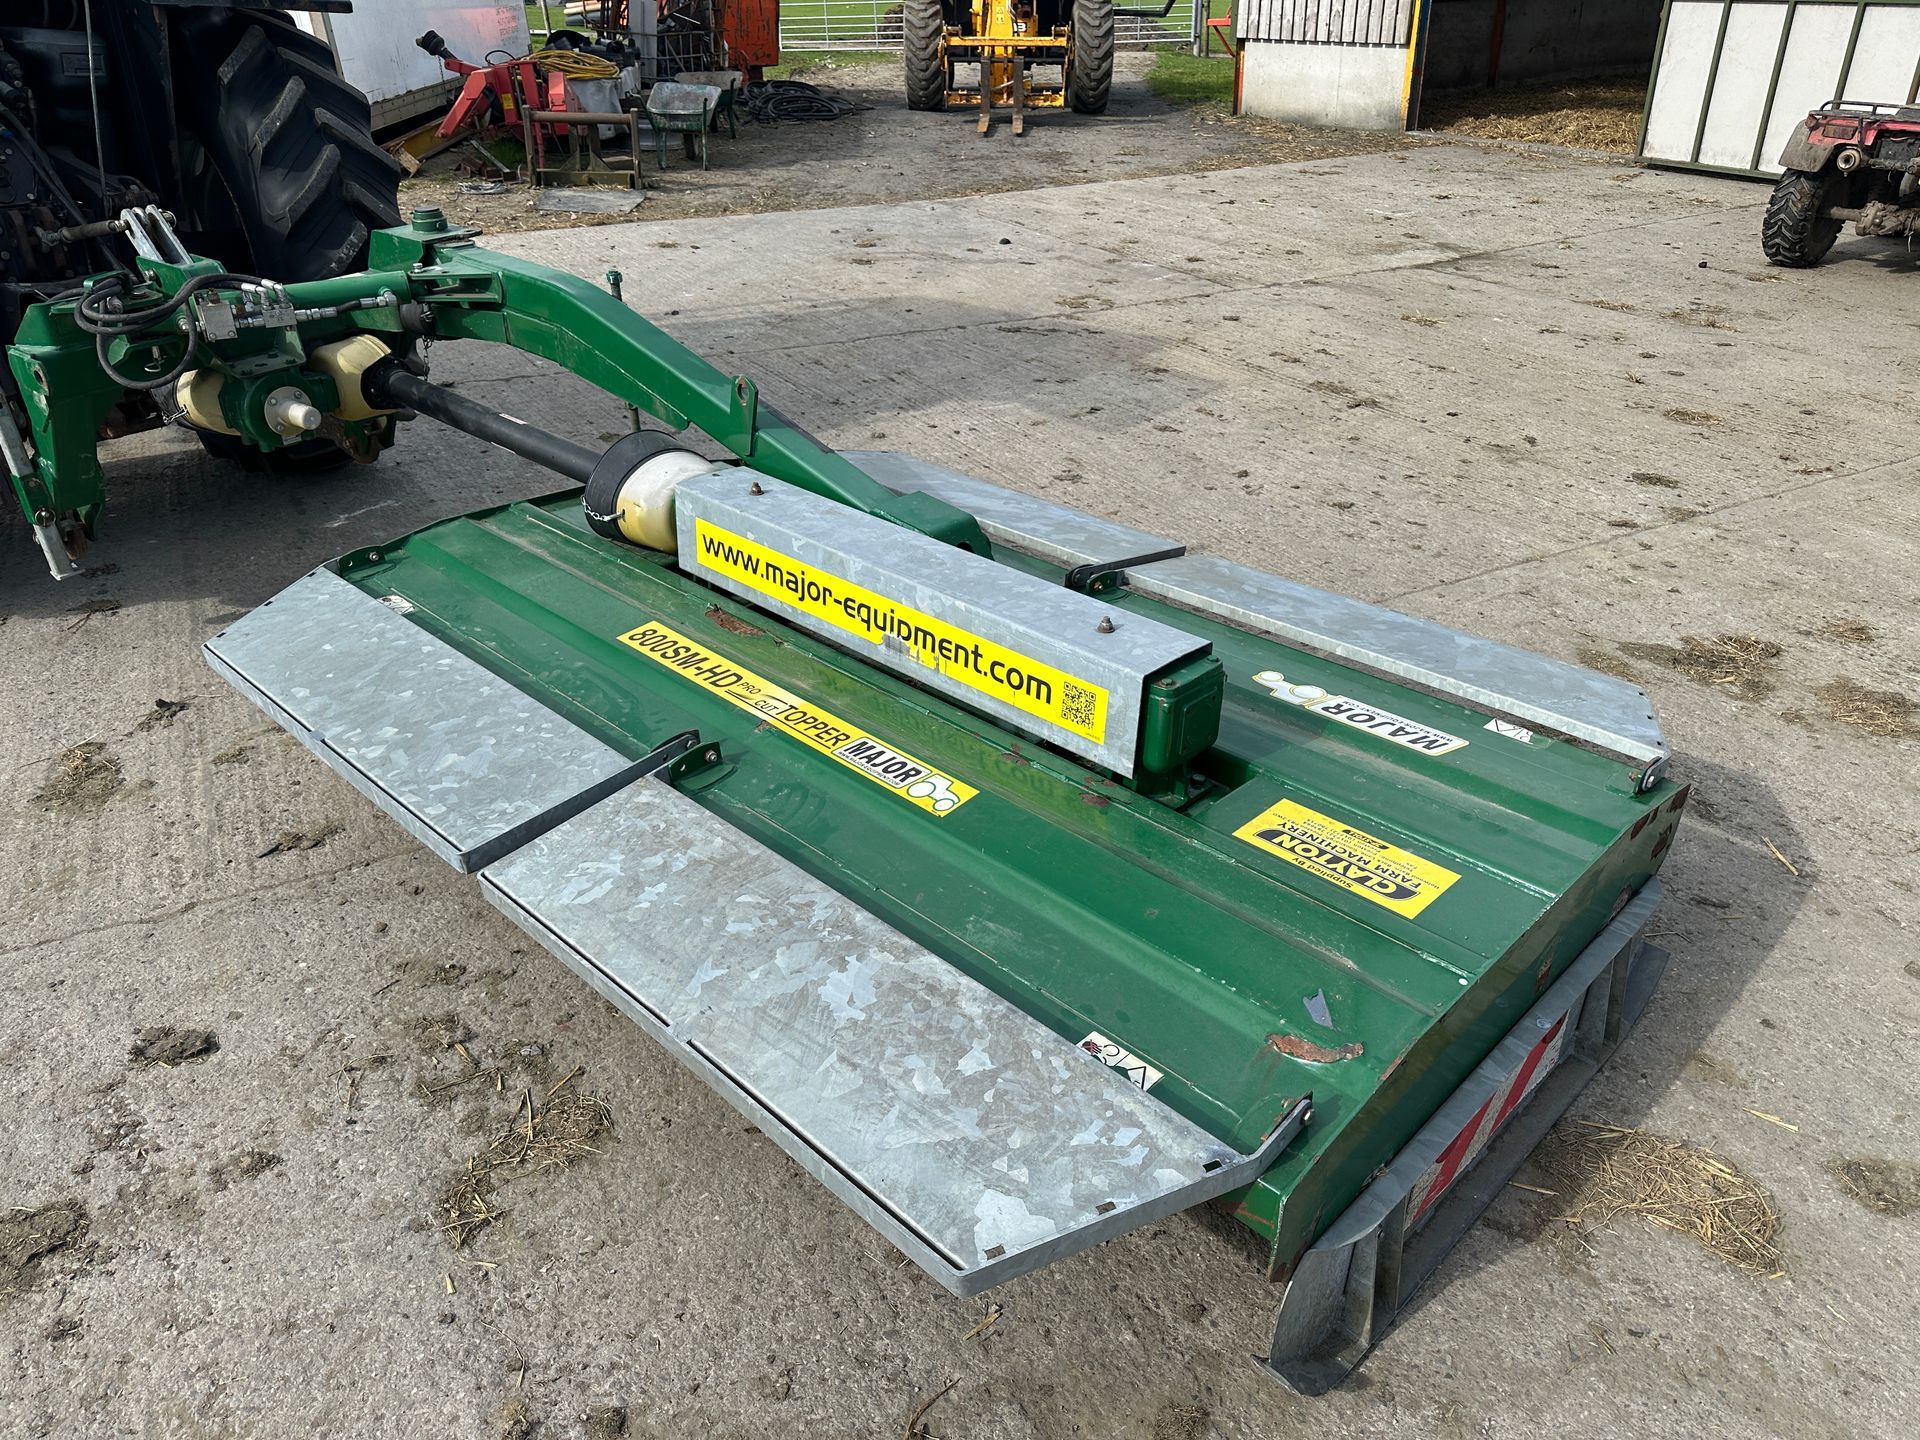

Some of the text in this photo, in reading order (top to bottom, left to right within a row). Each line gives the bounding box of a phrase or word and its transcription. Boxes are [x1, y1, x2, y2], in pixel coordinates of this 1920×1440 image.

[702, 533, 1052, 704] www.major-equipment.com
[628, 628, 851, 747] 800SM-HD PRO CUT TOPPER
[1321, 702, 1449, 751] MAJOR
[844, 741, 924, 783] MAJOR
[1270, 831, 1401, 896] CLAYTON
[1275, 819, 1423, 889] FARM MACHINERY
[1289, 855, 1355, 889] Supplied By
